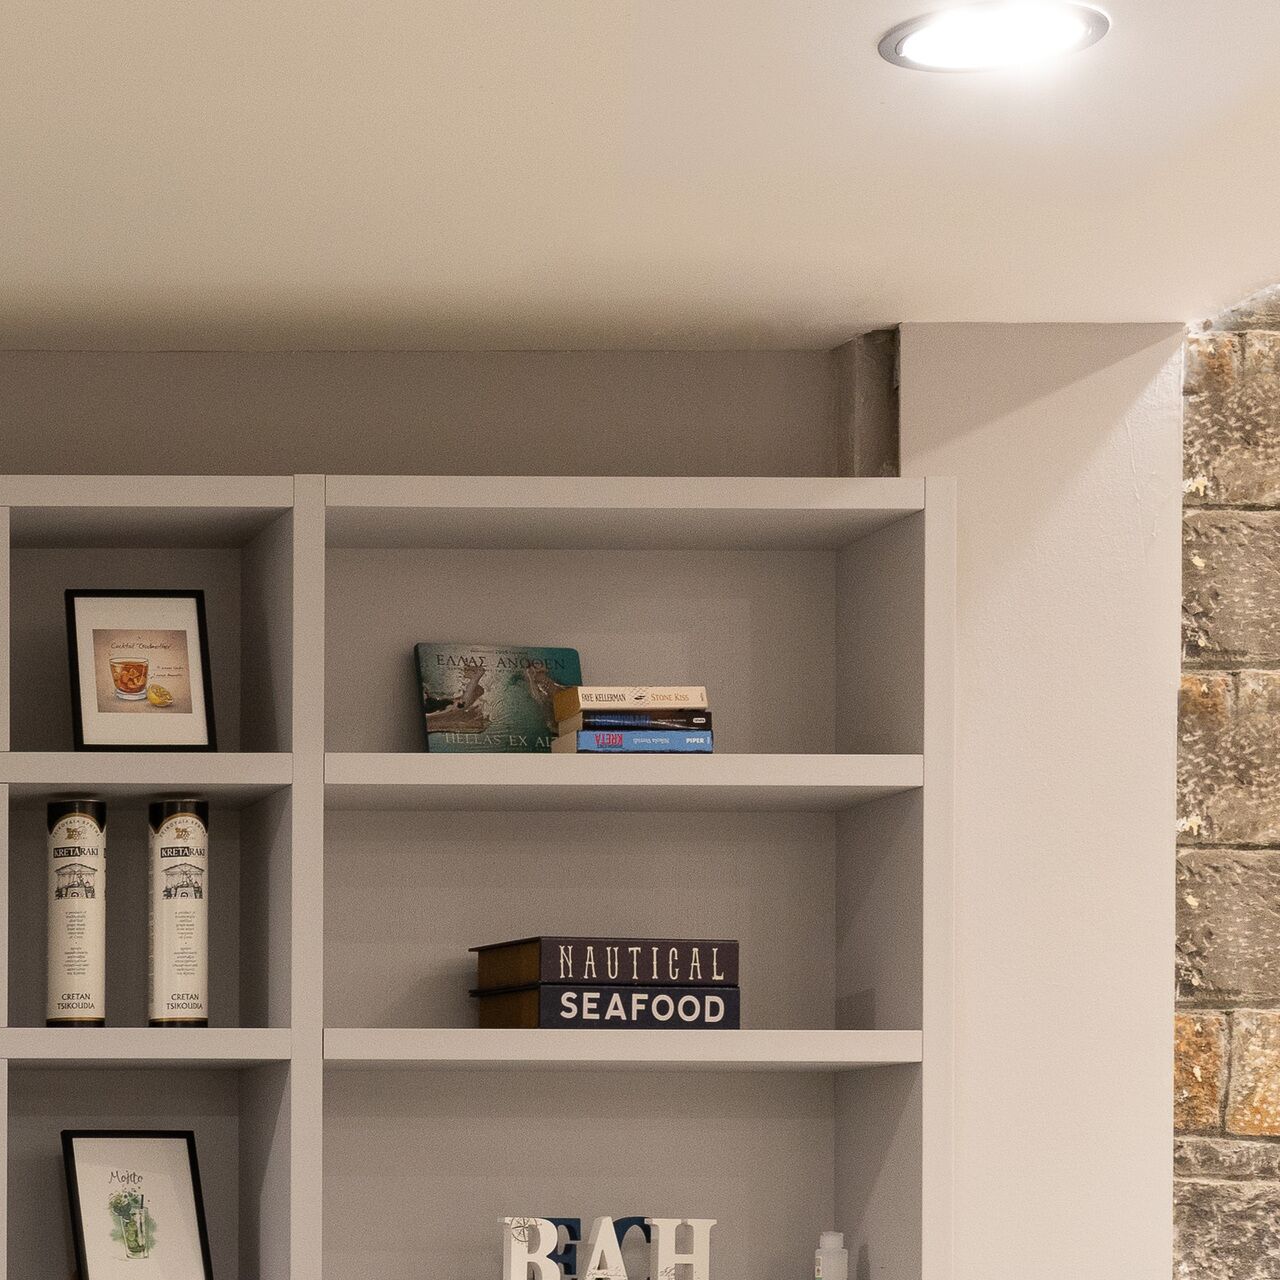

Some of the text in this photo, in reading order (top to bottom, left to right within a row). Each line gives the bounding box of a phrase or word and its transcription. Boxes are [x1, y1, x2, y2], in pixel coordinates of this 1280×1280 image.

[594, 693, 626, 702] KELLERMAN
[509, 735, 528, 747] EX
[594, 733, 624, 746] KRETA
[685, 737, 705, 745] PIPER
[559, 945, 725, 981] NAUTICAL
[61, 993, 91, 1001] CRETAN
[170, 993, 200, 1001] CRETAN
[57, 1002, 96, 1010] TSIKOUDIA
[166, 1002, 204, 1010] TSIKOUDIA
[559, 991, 725, 1023] SEAFOOD
[108, 1170, 143, 1185] Mojito
